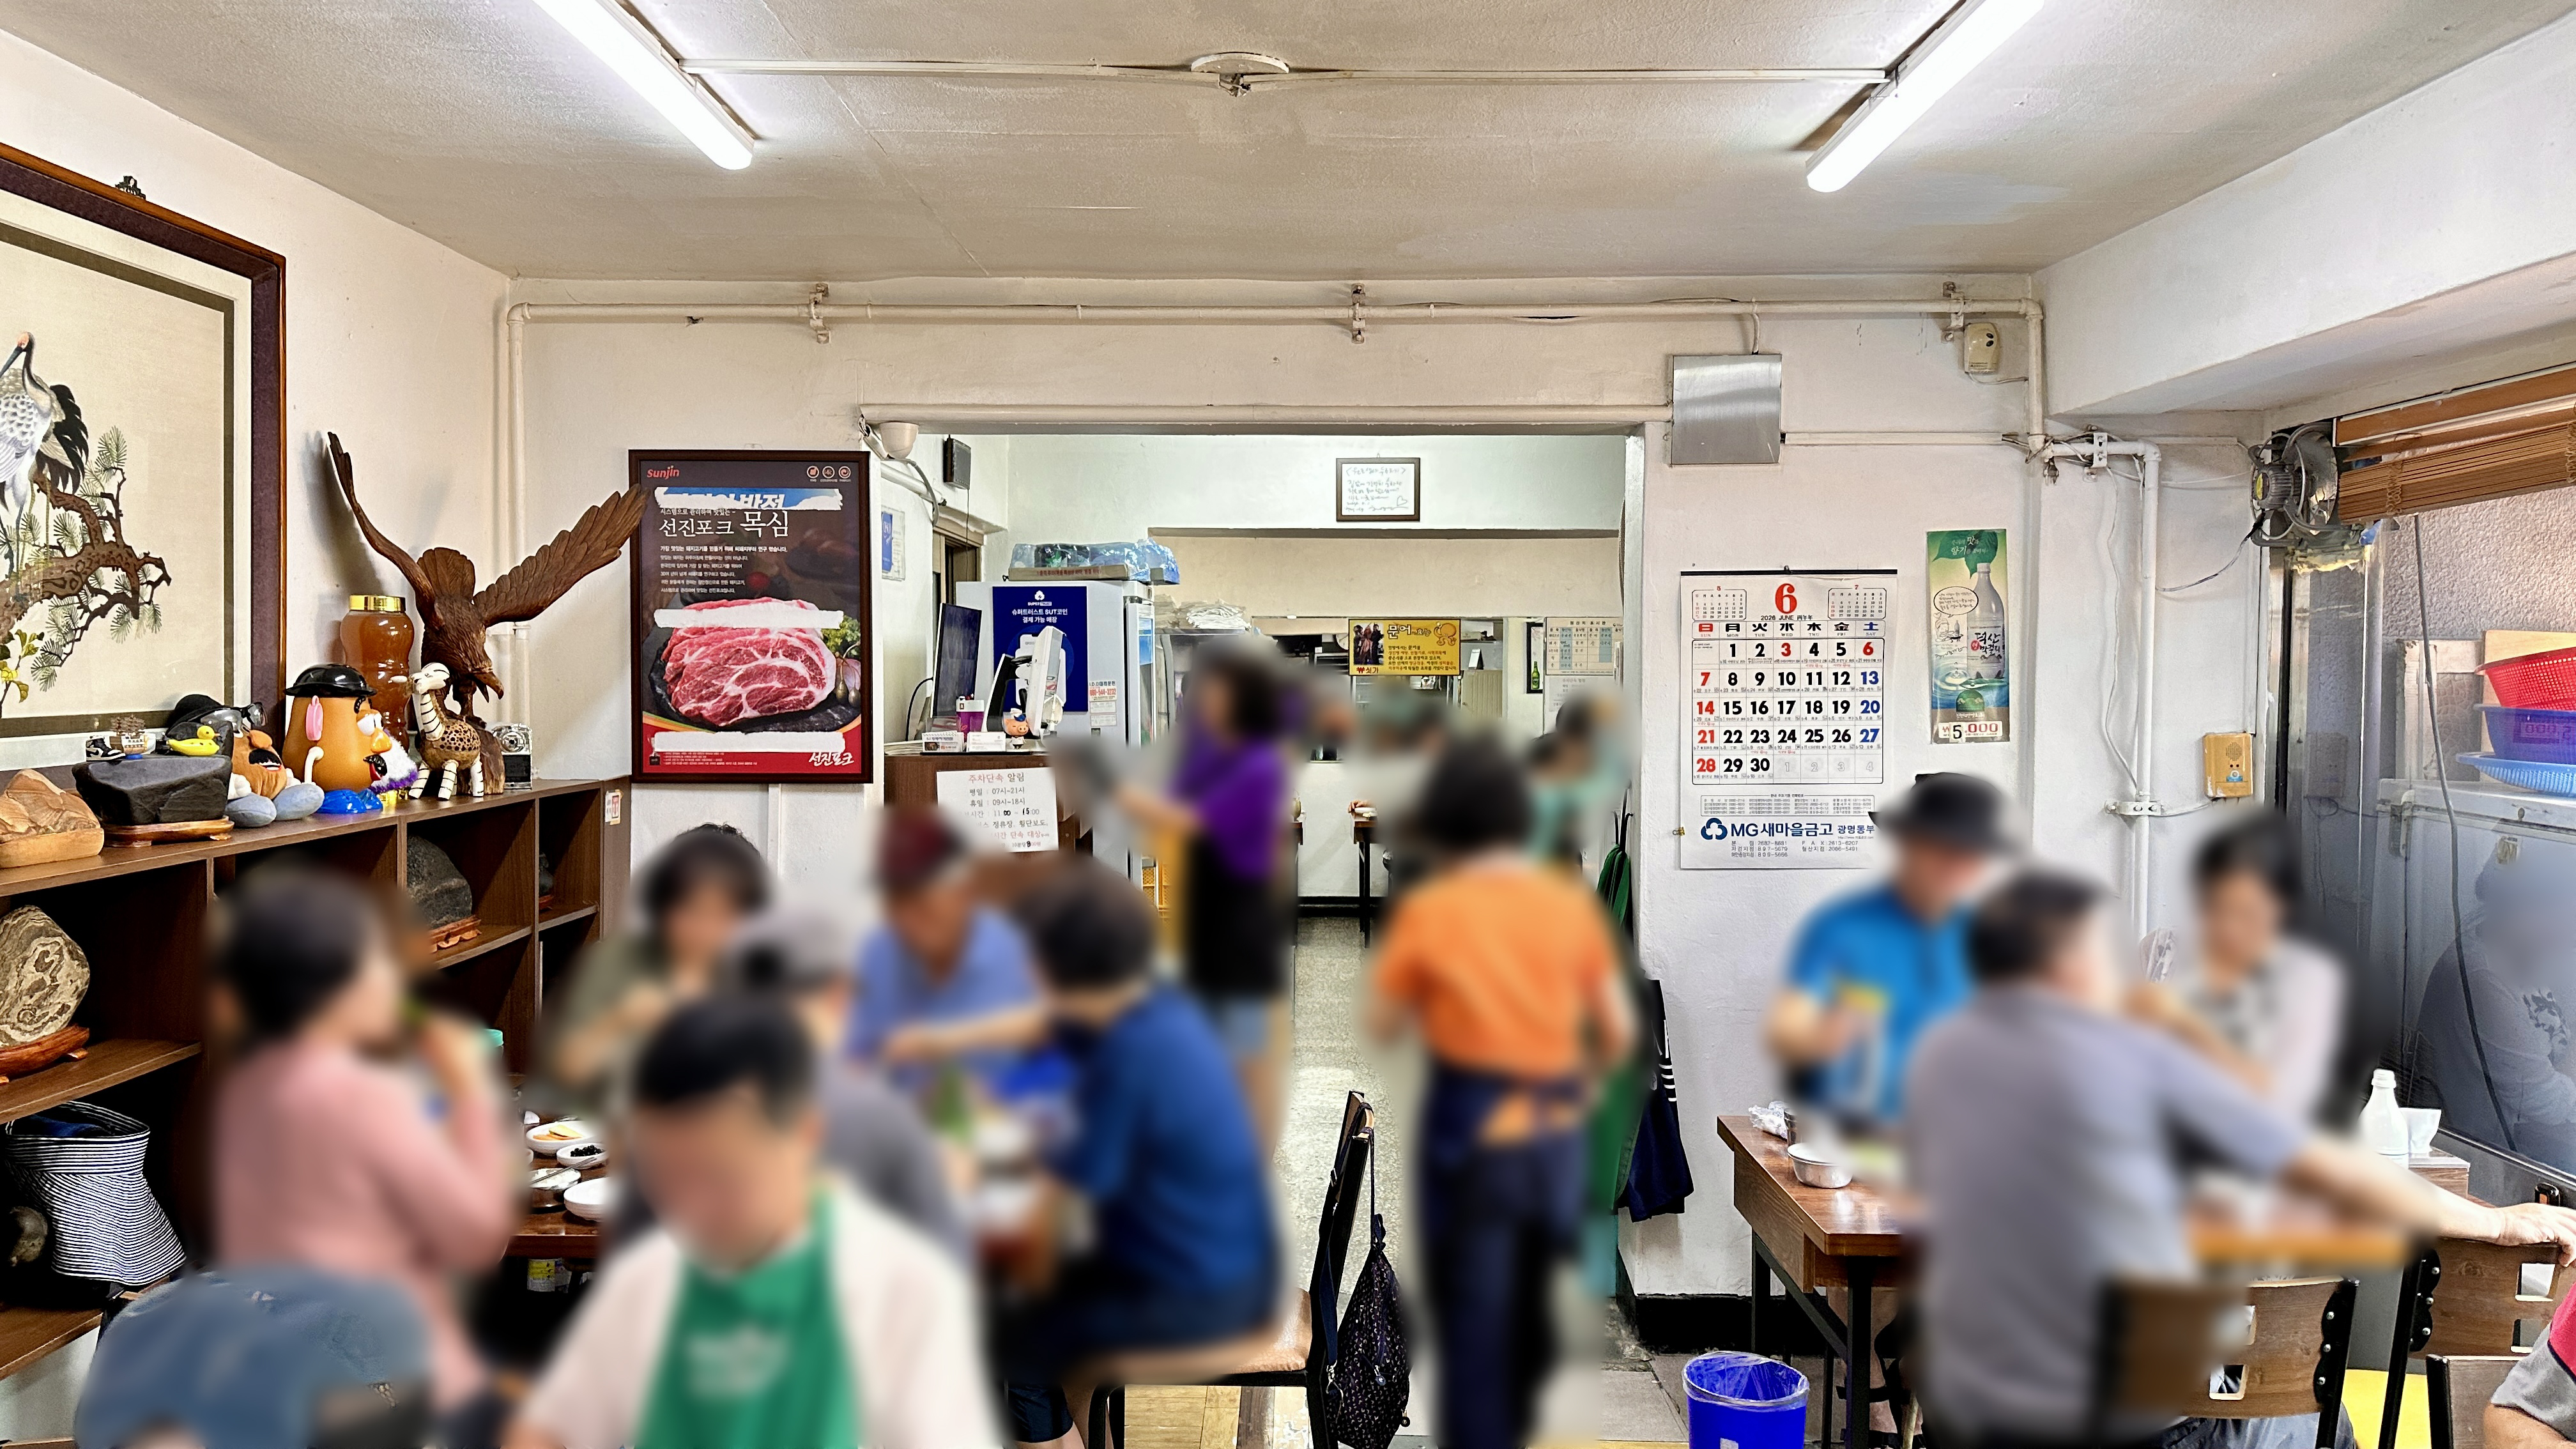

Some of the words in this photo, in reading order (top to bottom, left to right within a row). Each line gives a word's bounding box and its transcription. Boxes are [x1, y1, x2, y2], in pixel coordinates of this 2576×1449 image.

[647, 465, 680, 480] sunjin
[659, 518, 735, 537] 선진포크
[740, 510, 788, 538] 목심
[1775, 583, 1797, 614] 6
[1699, 623, 1713, 632] 日
[1726, 623, 1740, 632] 月
[1752, 622, 1767, 632] 火
[1779, 622, 1794, 632] 水
[1807, 622, 1821, 631] 木
[1834, 622, 1849, 631] 金
[1863, 622, 1878, 631] 土
[1975, 632, 2001, 645] 덕산
[1730, 644, 1735, 657] 1
[1755, 643, 1765, 657] 2
[1781, 643, 1791, 656] 3
[1809, 643, 1819, 656] 4
[1837, 642, 1846, 656] 5
[1863, 642, 1873, 656] 6
[1979, 644, 2000, 655] 막걸리
[1701, 672, 1710, 686] 7
[1728, 673, 1737, 686] 8
[1755, 672, 1765, 686] 9
[1779, 672, 1795, 686] 10
[1807, 671, 1821, 685] 11
[1833, 671, 1850, 685] 12
[1861, 671, 1878, 684] 13
[1697, 702, 1715, 714] 14
[1724, 701, 1742, 715] 15
[1751, 701, 1768, 714] 16
[1778, 701, 1796, 714] 17
[1805, 700, 1823, 714] 18
[1833, 700, 1850, 714] 19
[1860, 700, 1880, 714] 20
[1698, 730, 1715, 743] 21
[1724, 730, 1743, 743] 22
[1751, 730, 1770, 743] 23
[1778, 730, 1797, 743] 24
[1805, 729, 1823, 742] 25
[1832, 729, 1851, 742] 26
[1860, 729, 1880, 742] 27
[809, 751, 855, 767] 선진포크
[1697, 758, 1716, 772] 28
[1724, 758, 1743, 772] 29
[1751, 758, 1770, 772] 30
[969, 773, 1004, 783] 주차단속
[1007, 772, 1024, 783] 알림
[992, 786, 1025, 795] 07시~21시
[1010, 831, 1024, 839] 단속
[1837, 825, 1874, 834] 광명동부
